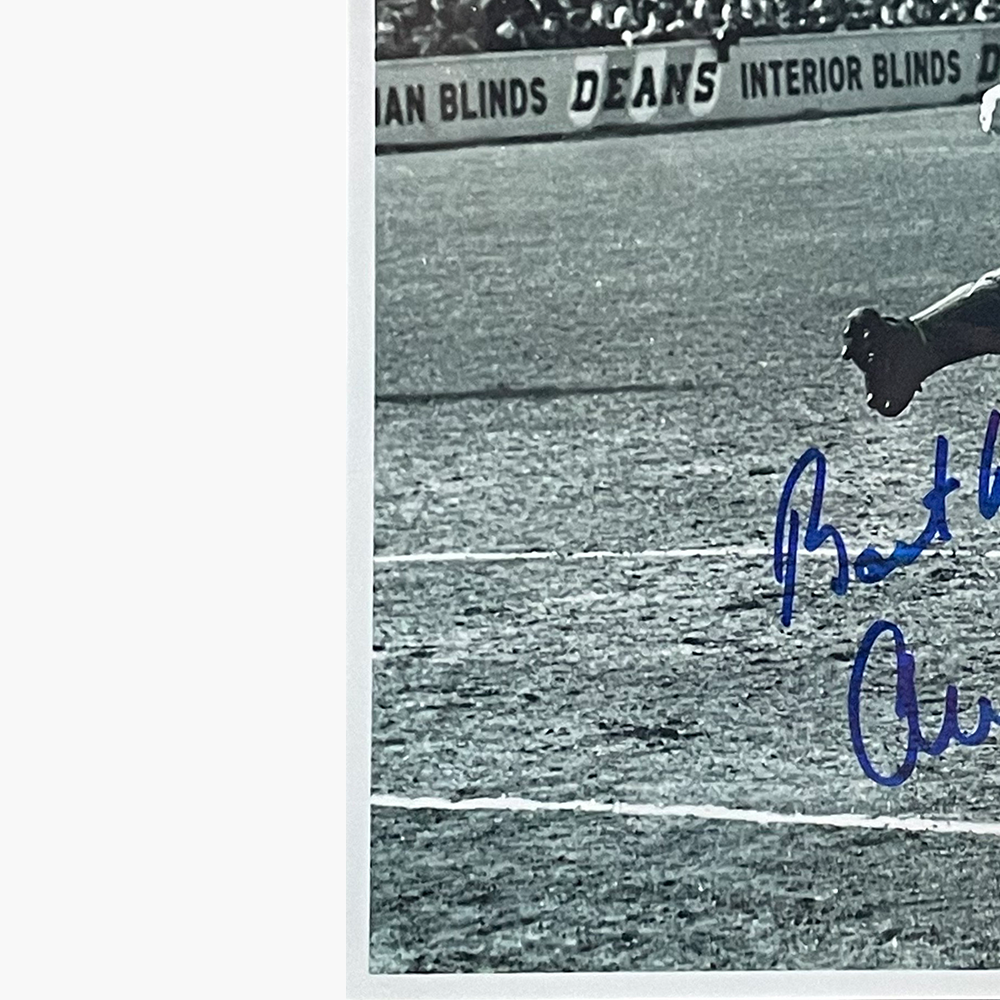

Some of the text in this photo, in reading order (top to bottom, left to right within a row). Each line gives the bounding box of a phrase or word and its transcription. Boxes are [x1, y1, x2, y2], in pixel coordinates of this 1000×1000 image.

[439, 77, 548, 123] BLINDS
[570, 61, 719, 112] DEANS
[740, 56, 863, 101] INTERIOR
[872, 49, 962, 92] BLINDS
